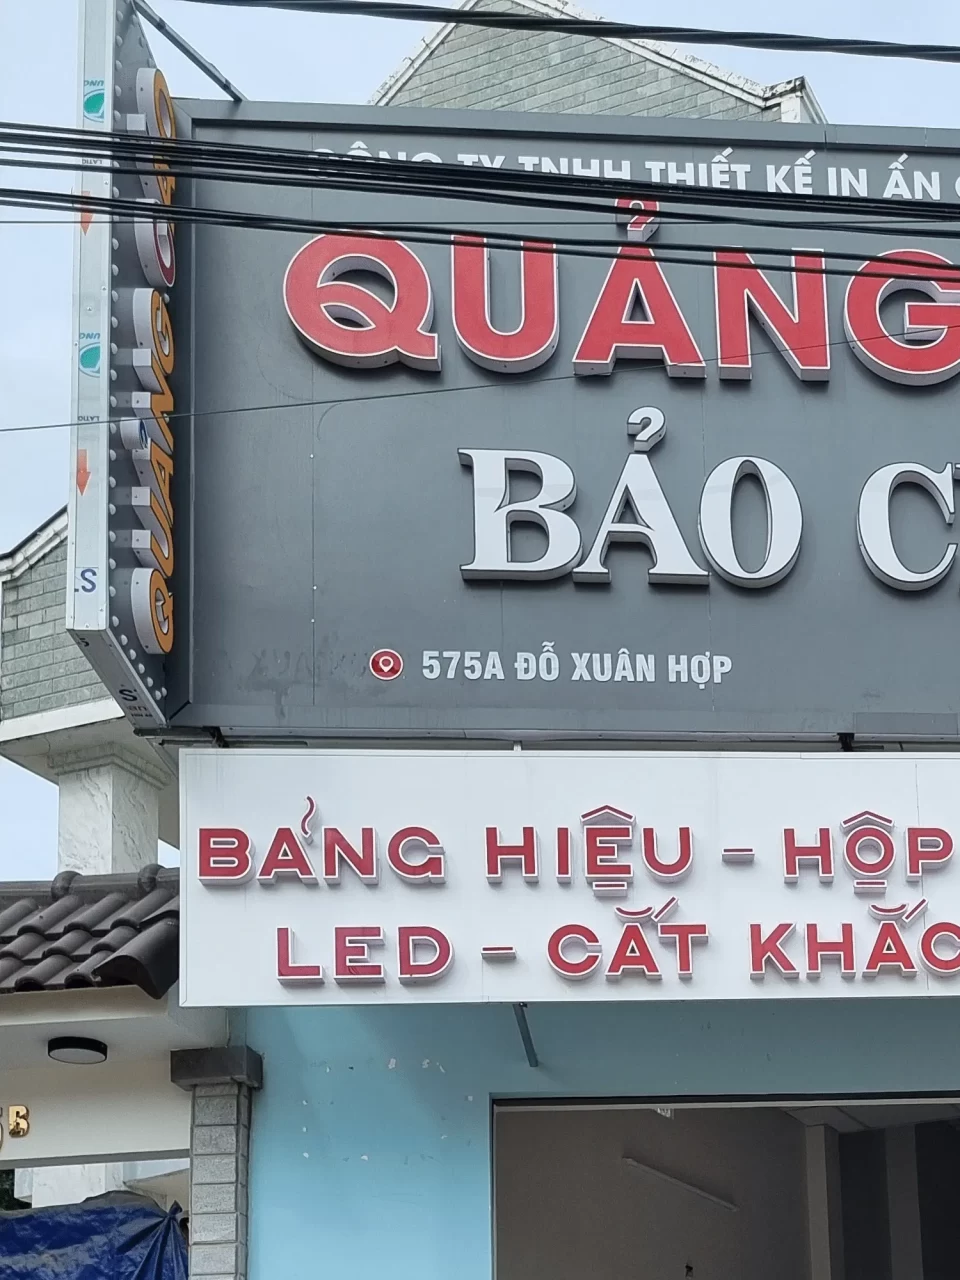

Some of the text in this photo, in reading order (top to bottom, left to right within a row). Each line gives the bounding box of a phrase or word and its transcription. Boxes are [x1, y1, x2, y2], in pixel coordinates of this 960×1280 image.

[645, 147, 751, 190] THIẾT
[766, 149, 817, 195] KẾ
[827, 167, 868, 197] IN
[882, 153, 941, 200] ẤN
[458, 406, 804, 588] BẢO
[422, 641, 733, 693] 575A ĐỖ XUÂN HỢP
[197, 795, 447, 886] BẢNG
[485, 804, 693, 897] HIỆU
[782, 810, 956, 894] HỘP
[276, 925, 454, 985] LED
[546, 896, 709, 982] CẮT
